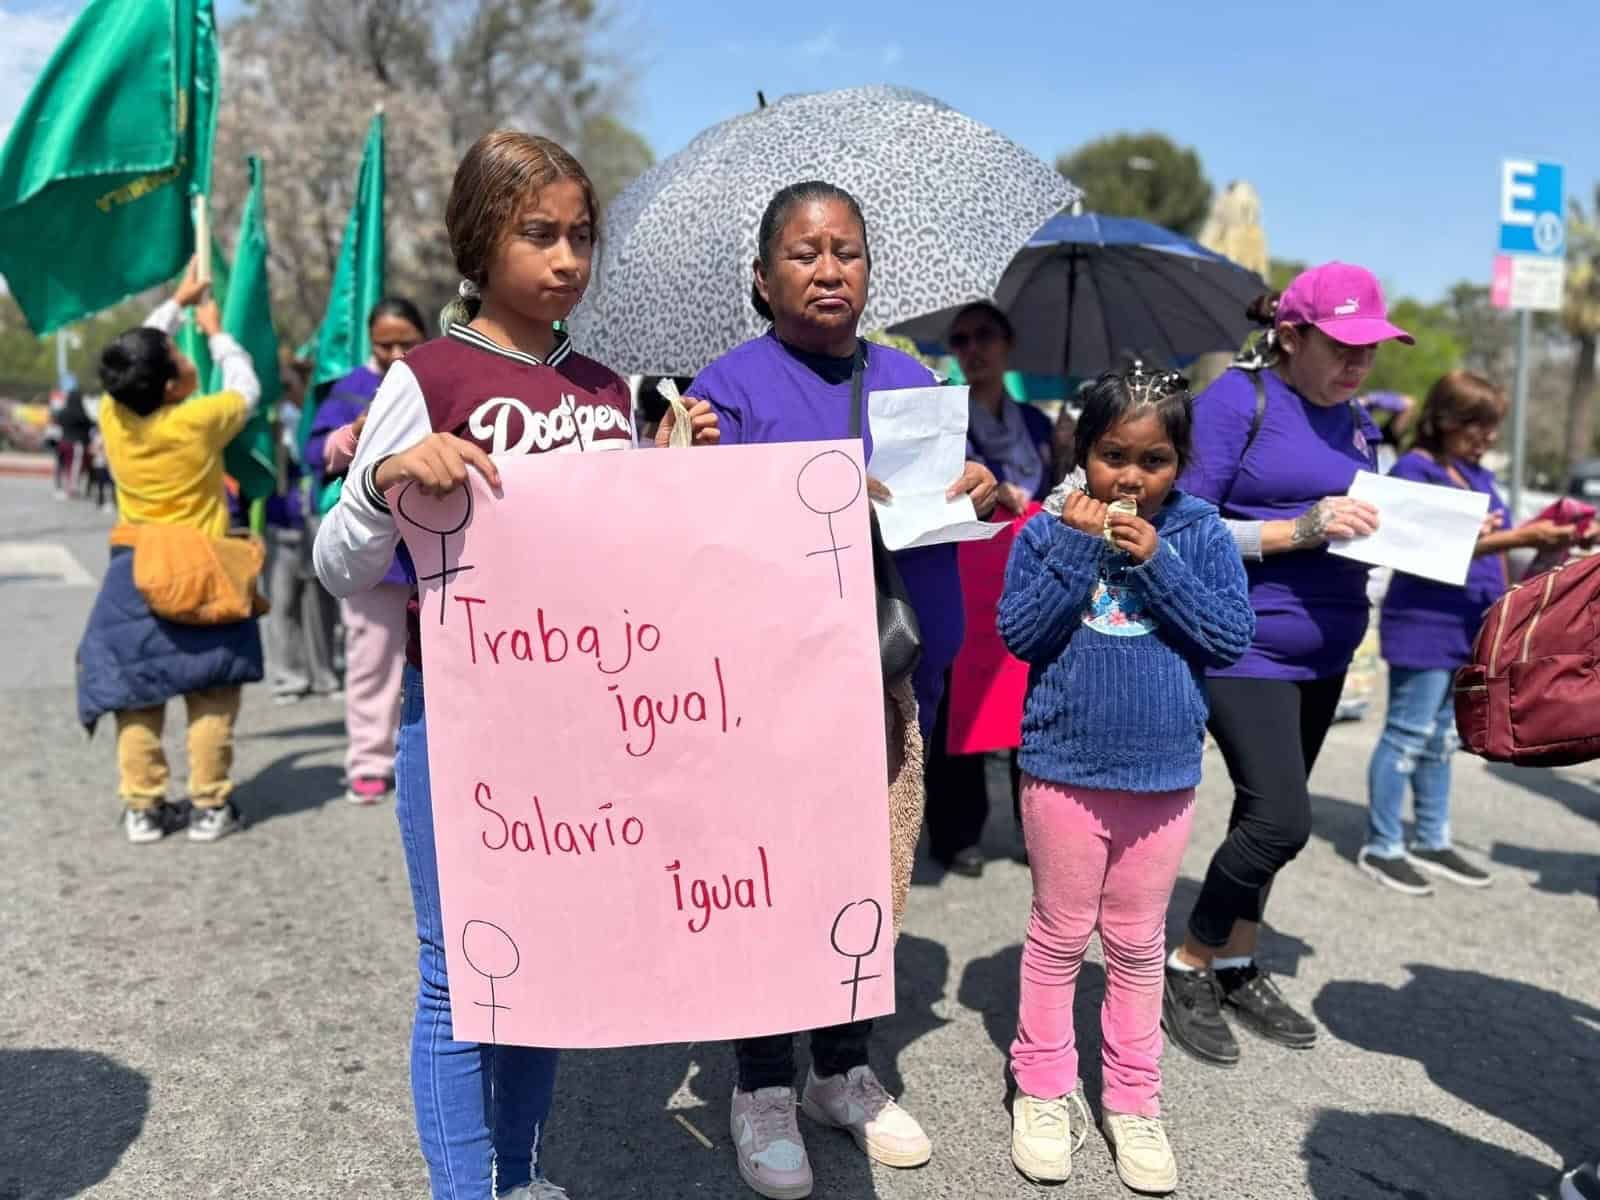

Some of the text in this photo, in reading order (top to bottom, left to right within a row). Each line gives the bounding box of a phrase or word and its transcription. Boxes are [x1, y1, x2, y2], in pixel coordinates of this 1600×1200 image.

[1503, 161, 1536, 223] E
[469, 392, 632, 455] Dodger
[454, 596, 660, 673] Trabajo
[475, 782, 644, 855] Salario
[665, 846, 771, 932] igual
